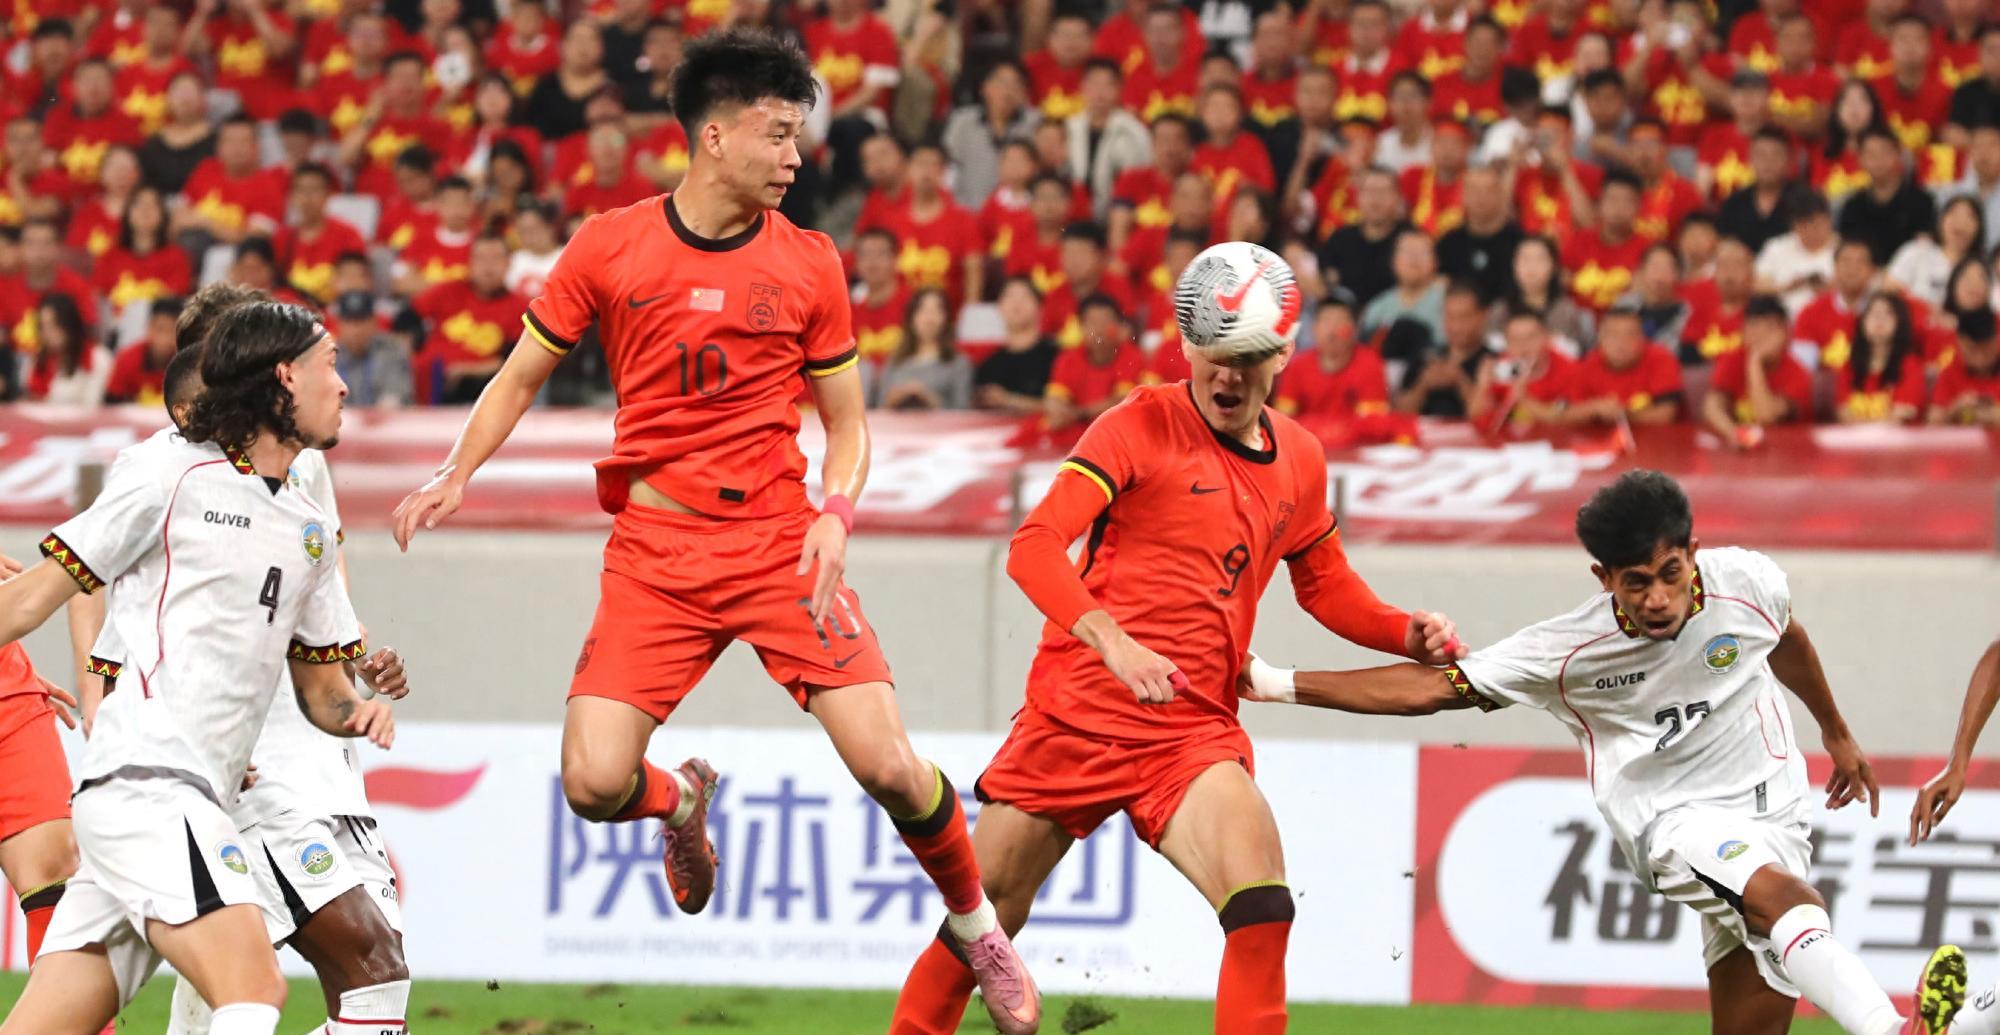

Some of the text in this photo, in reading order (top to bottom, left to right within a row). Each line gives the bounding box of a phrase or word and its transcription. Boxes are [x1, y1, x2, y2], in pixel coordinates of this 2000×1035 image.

[676, 342, 728, 397] 10
[204, 510, 252, 530] OLIVER
[258, 566, 282, 625] 4
[1217, 543, 1251, 597] 9
[1595, 671, 1646, 690] OLIVER
[1544, 816, 2000, 953] 福宝
